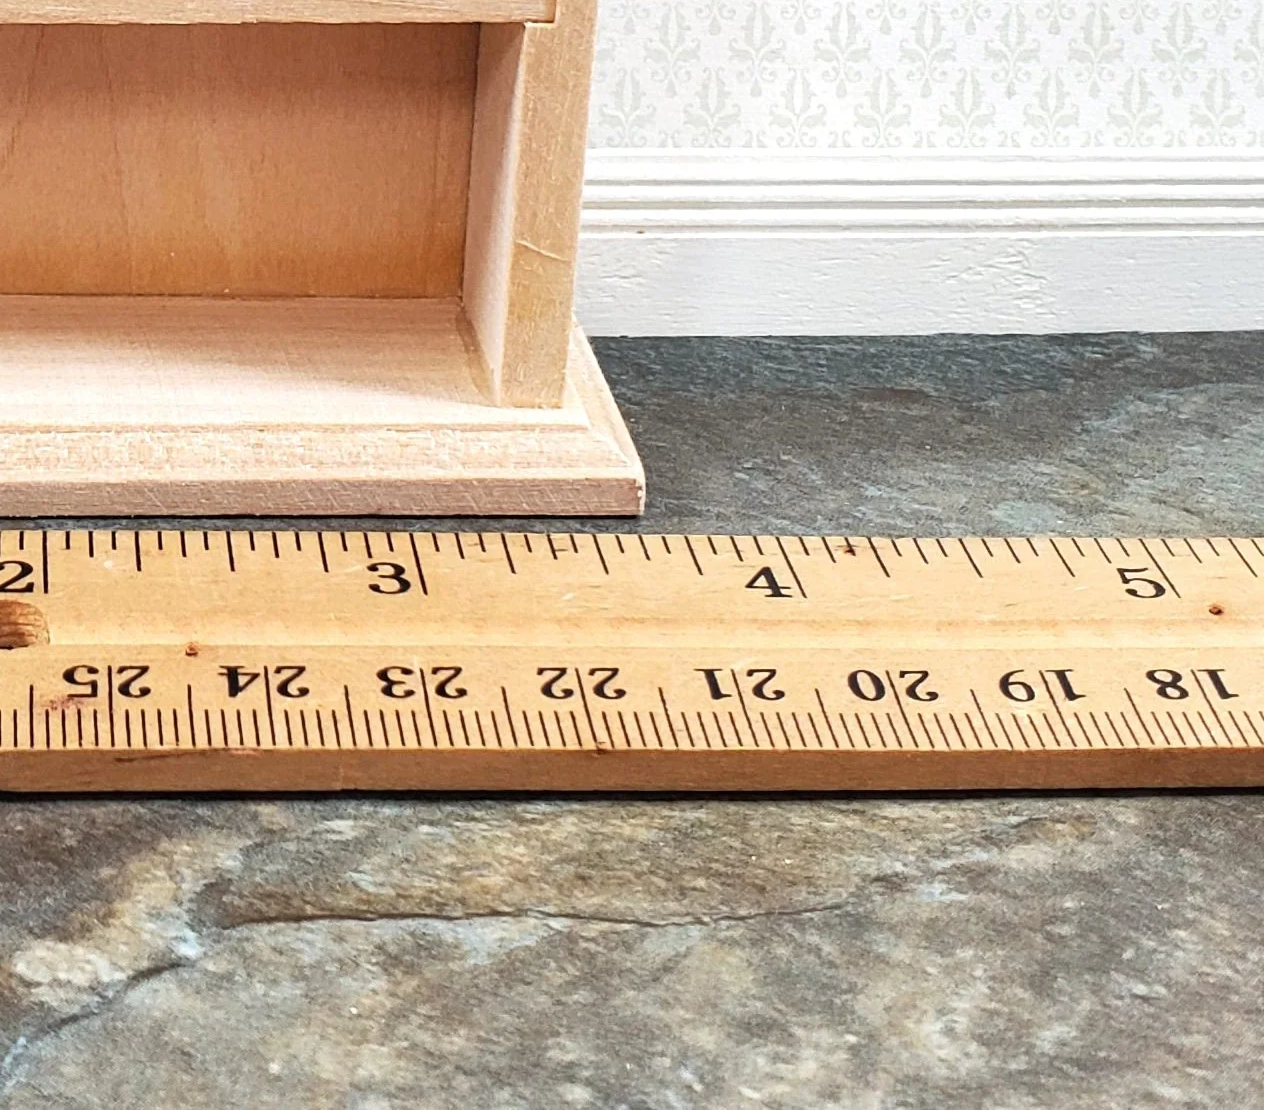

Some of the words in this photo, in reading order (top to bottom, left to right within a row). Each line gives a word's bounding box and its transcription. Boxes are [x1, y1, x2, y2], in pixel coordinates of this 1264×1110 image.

[366, 562, 412, 595] 3
[744, 566, 793, 598] 4
[1116, 567, 1166, 599] 5
[62, 665, 152, 699] 25
[218, 665, 310, 699] 24
[376, 665, 468, 699] 23
[536, 667, 627, 700] 22
[694, 668, 786, 701] 21
[847, 669, 939, 702] 20
[999, 668, 1086, 702] 19
[1145, 668, 1239, 700] 18
